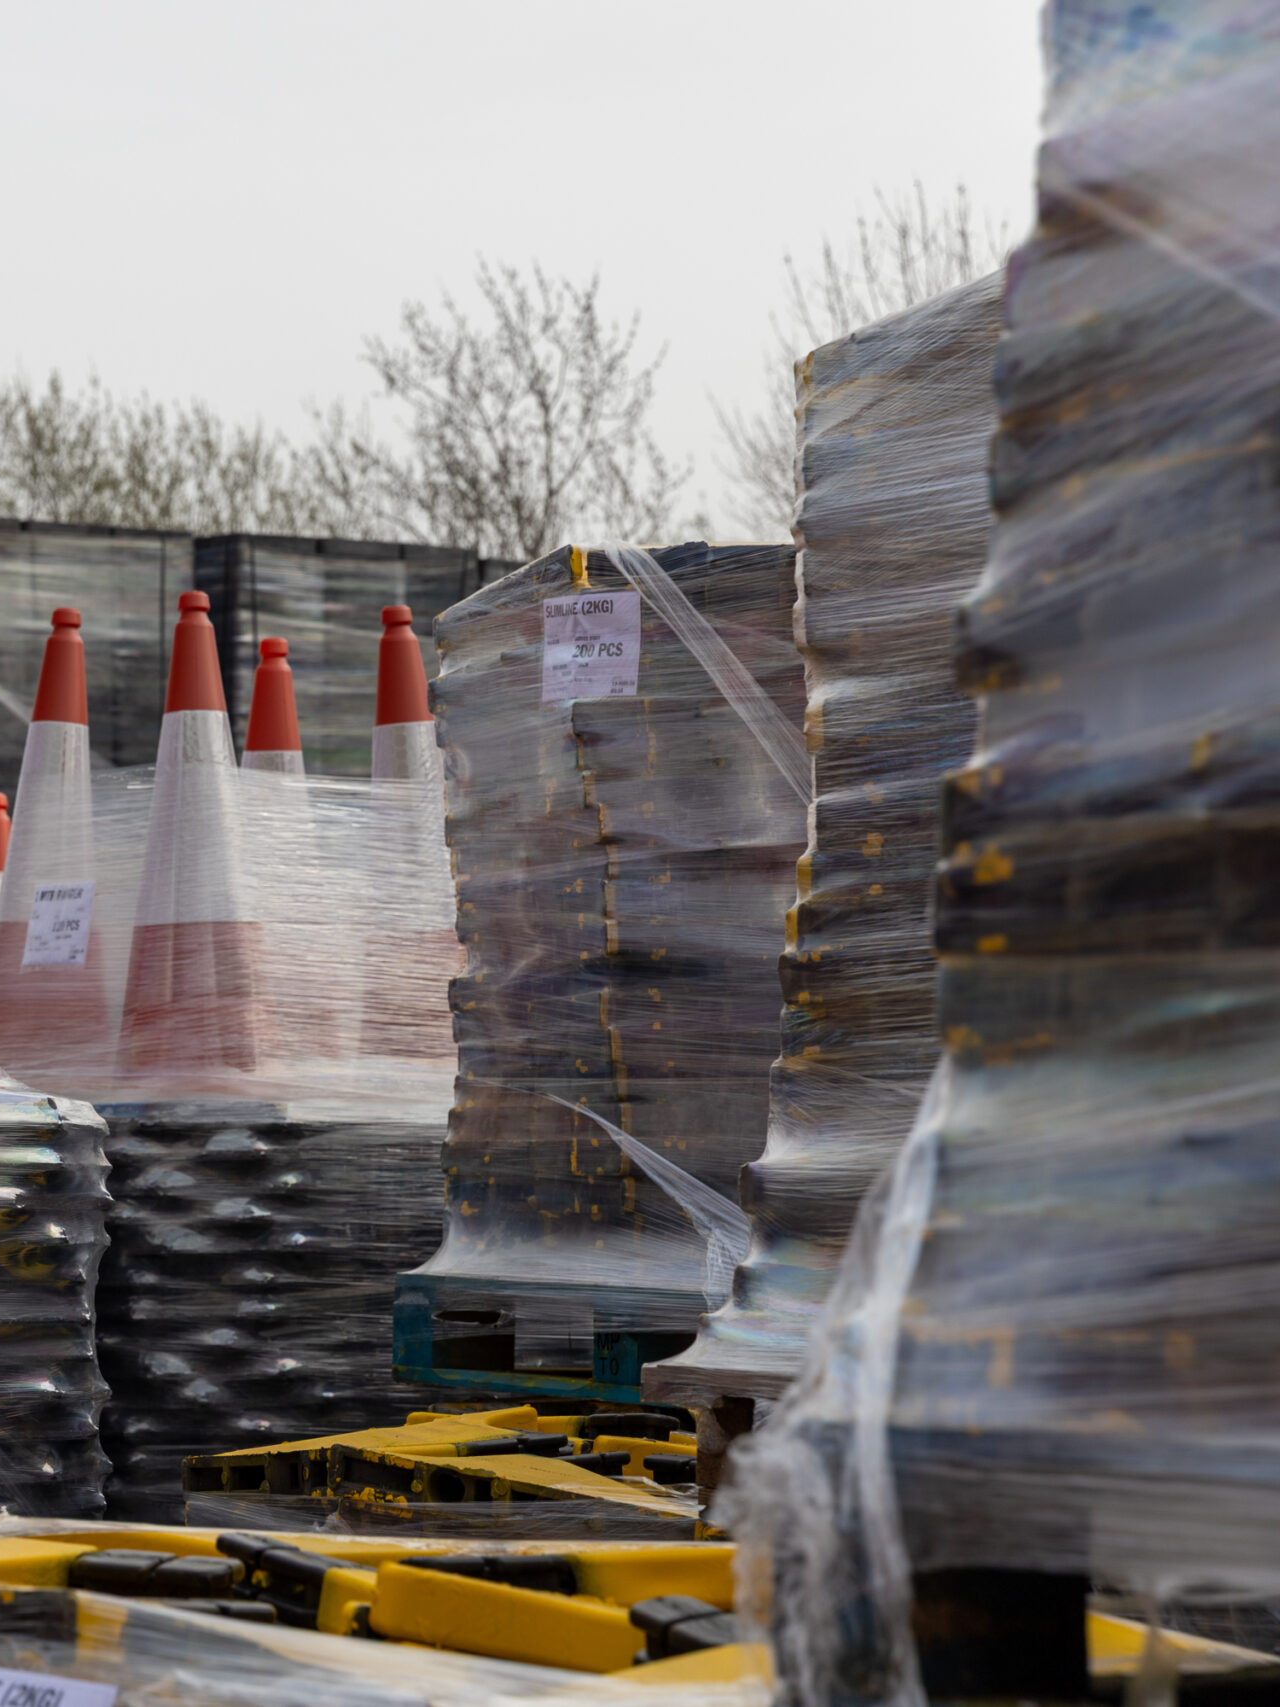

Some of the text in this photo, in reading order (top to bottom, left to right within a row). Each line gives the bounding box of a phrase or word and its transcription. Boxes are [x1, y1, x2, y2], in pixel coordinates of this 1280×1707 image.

[545, 599, 614, 618] SLIMLINE (2KG)
[572, 642, 623, 658] 200 PCS
